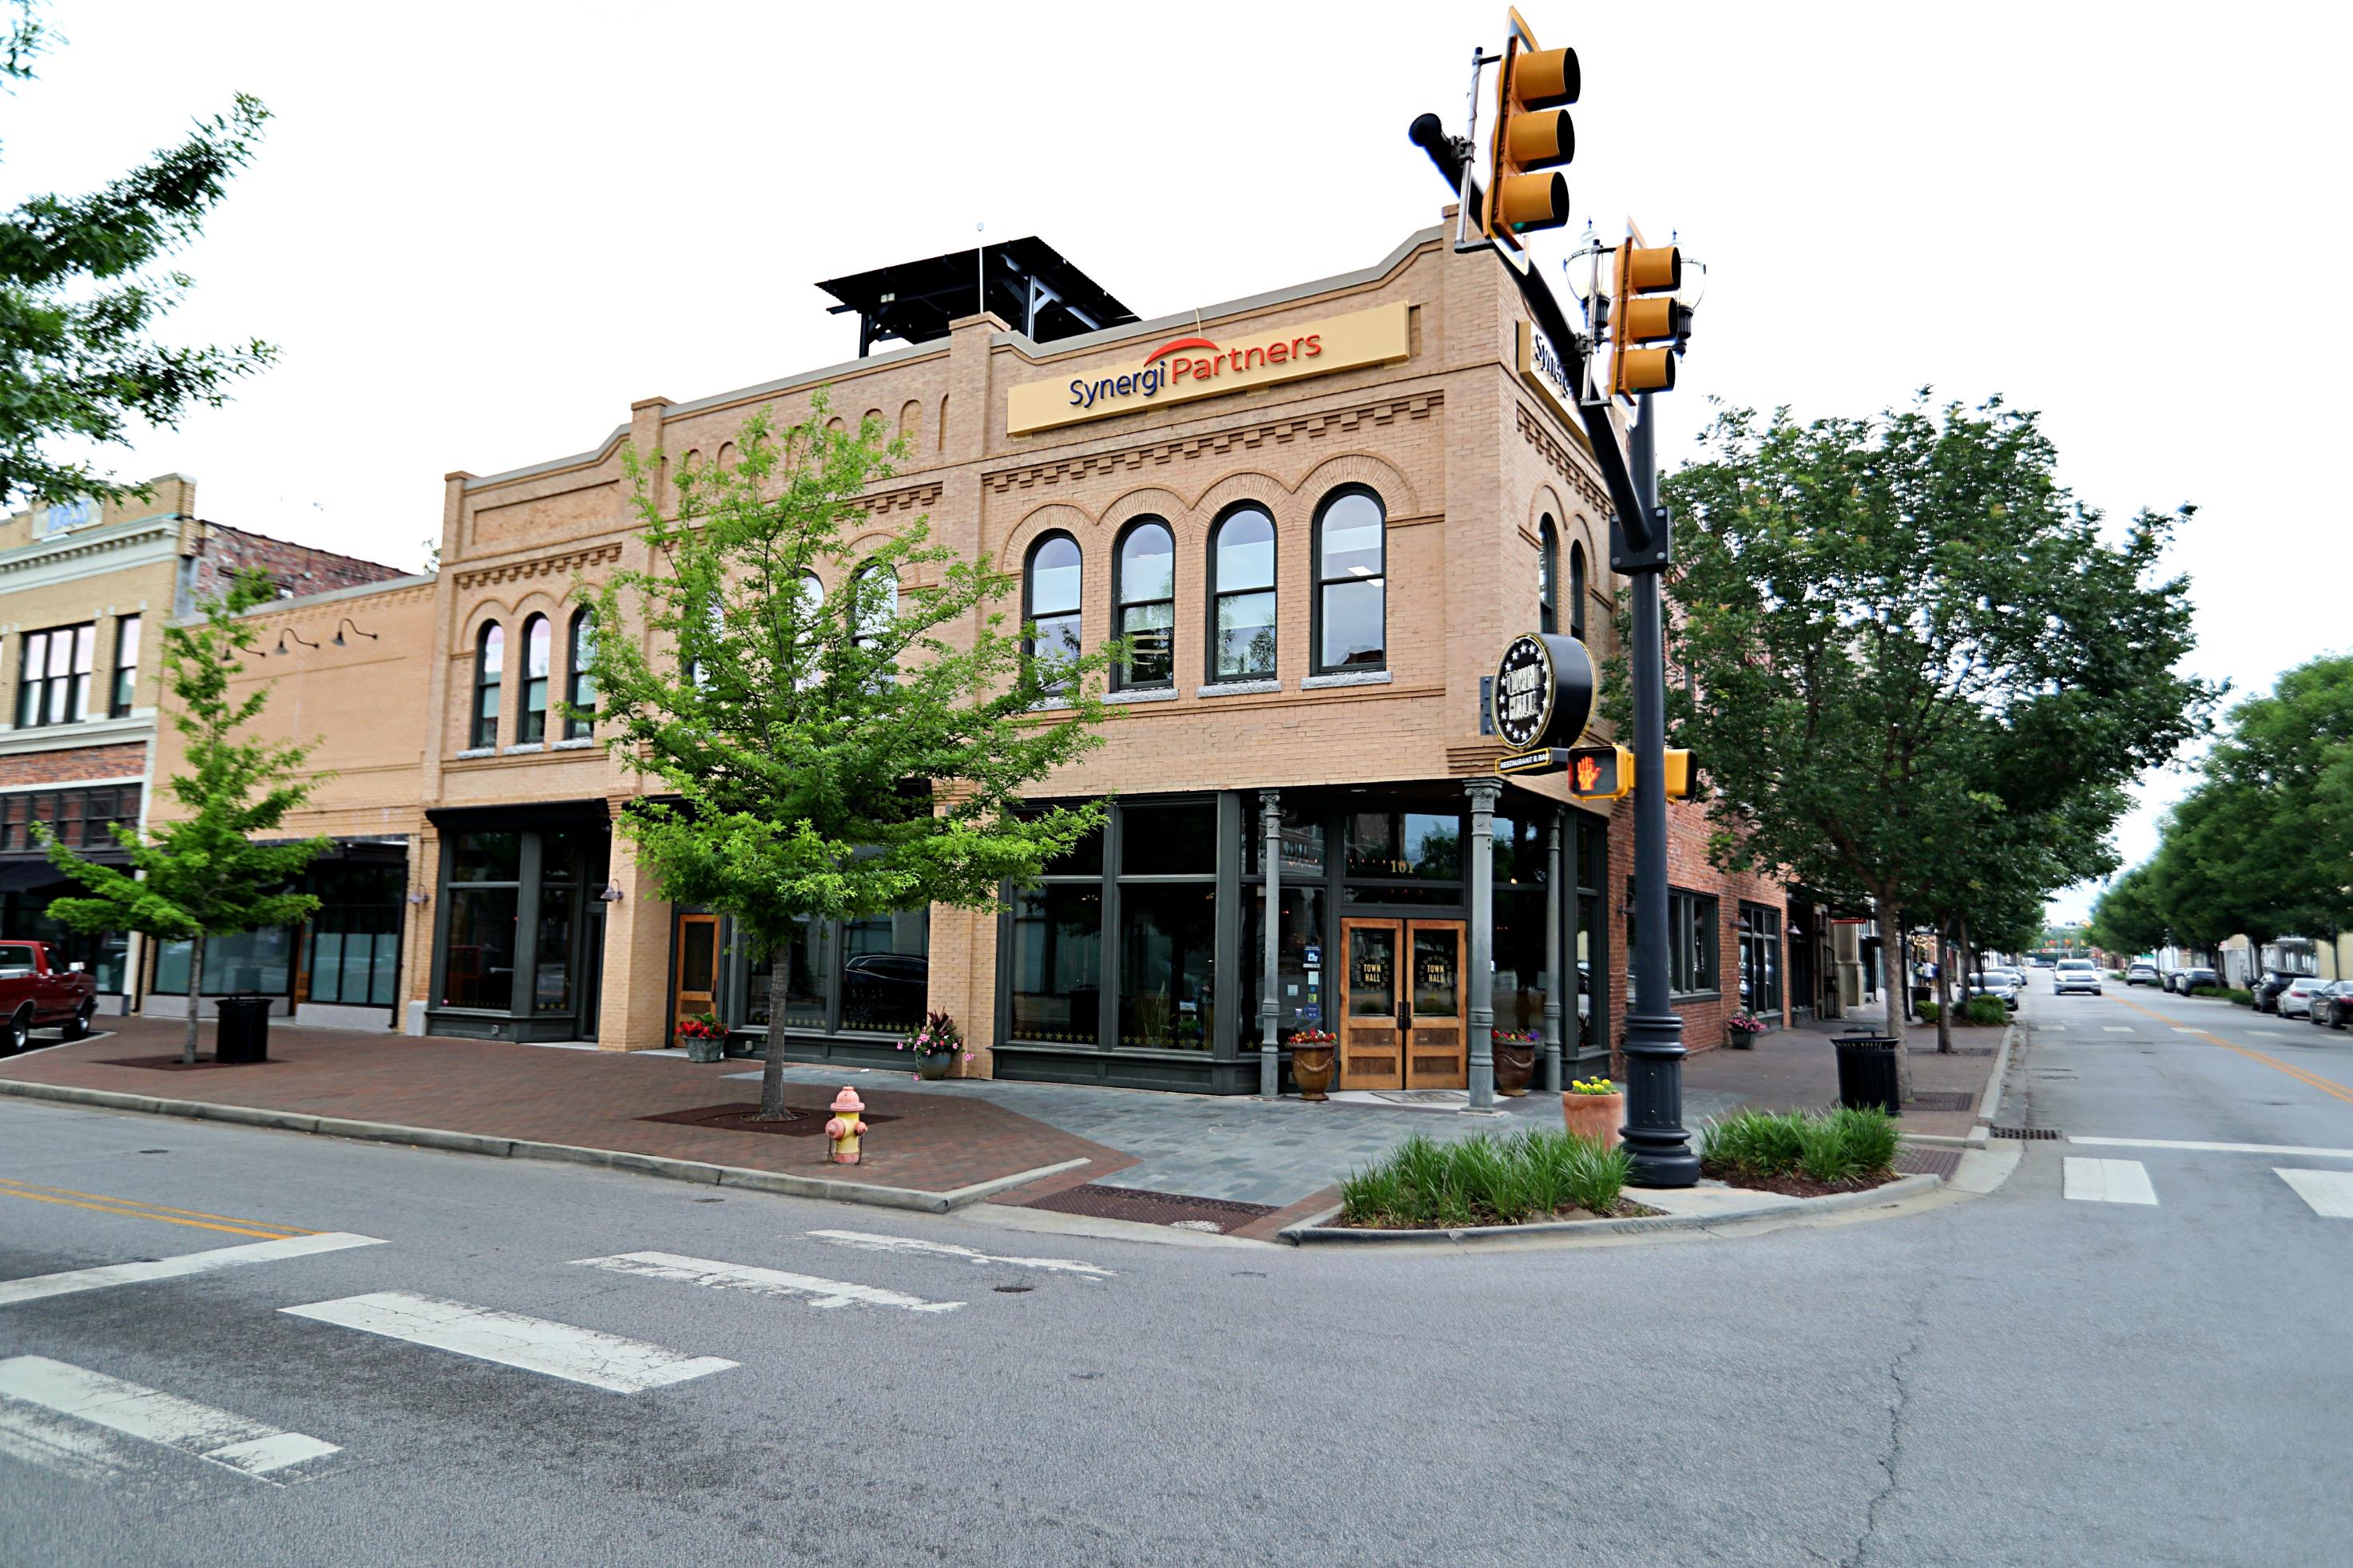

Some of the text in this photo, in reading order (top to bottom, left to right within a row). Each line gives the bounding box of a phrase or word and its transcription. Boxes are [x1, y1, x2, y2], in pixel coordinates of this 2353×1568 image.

[1069, 333, 1323, 408] Synergi Partners
[1506, 663, 1538, 697] TOWN
[1508, 690, 1538, 721] HALL
[1500, 756, 1533, 769] RESTAURANT
[1390, 859, 1414, 874] 101
[1363, 963, 1381, 973] TOWN
[1426, 964, 1445, 973] TOWN
[1364, 973, 1381, 982] HALL
[1428, 974, 1445, 983] HALL
